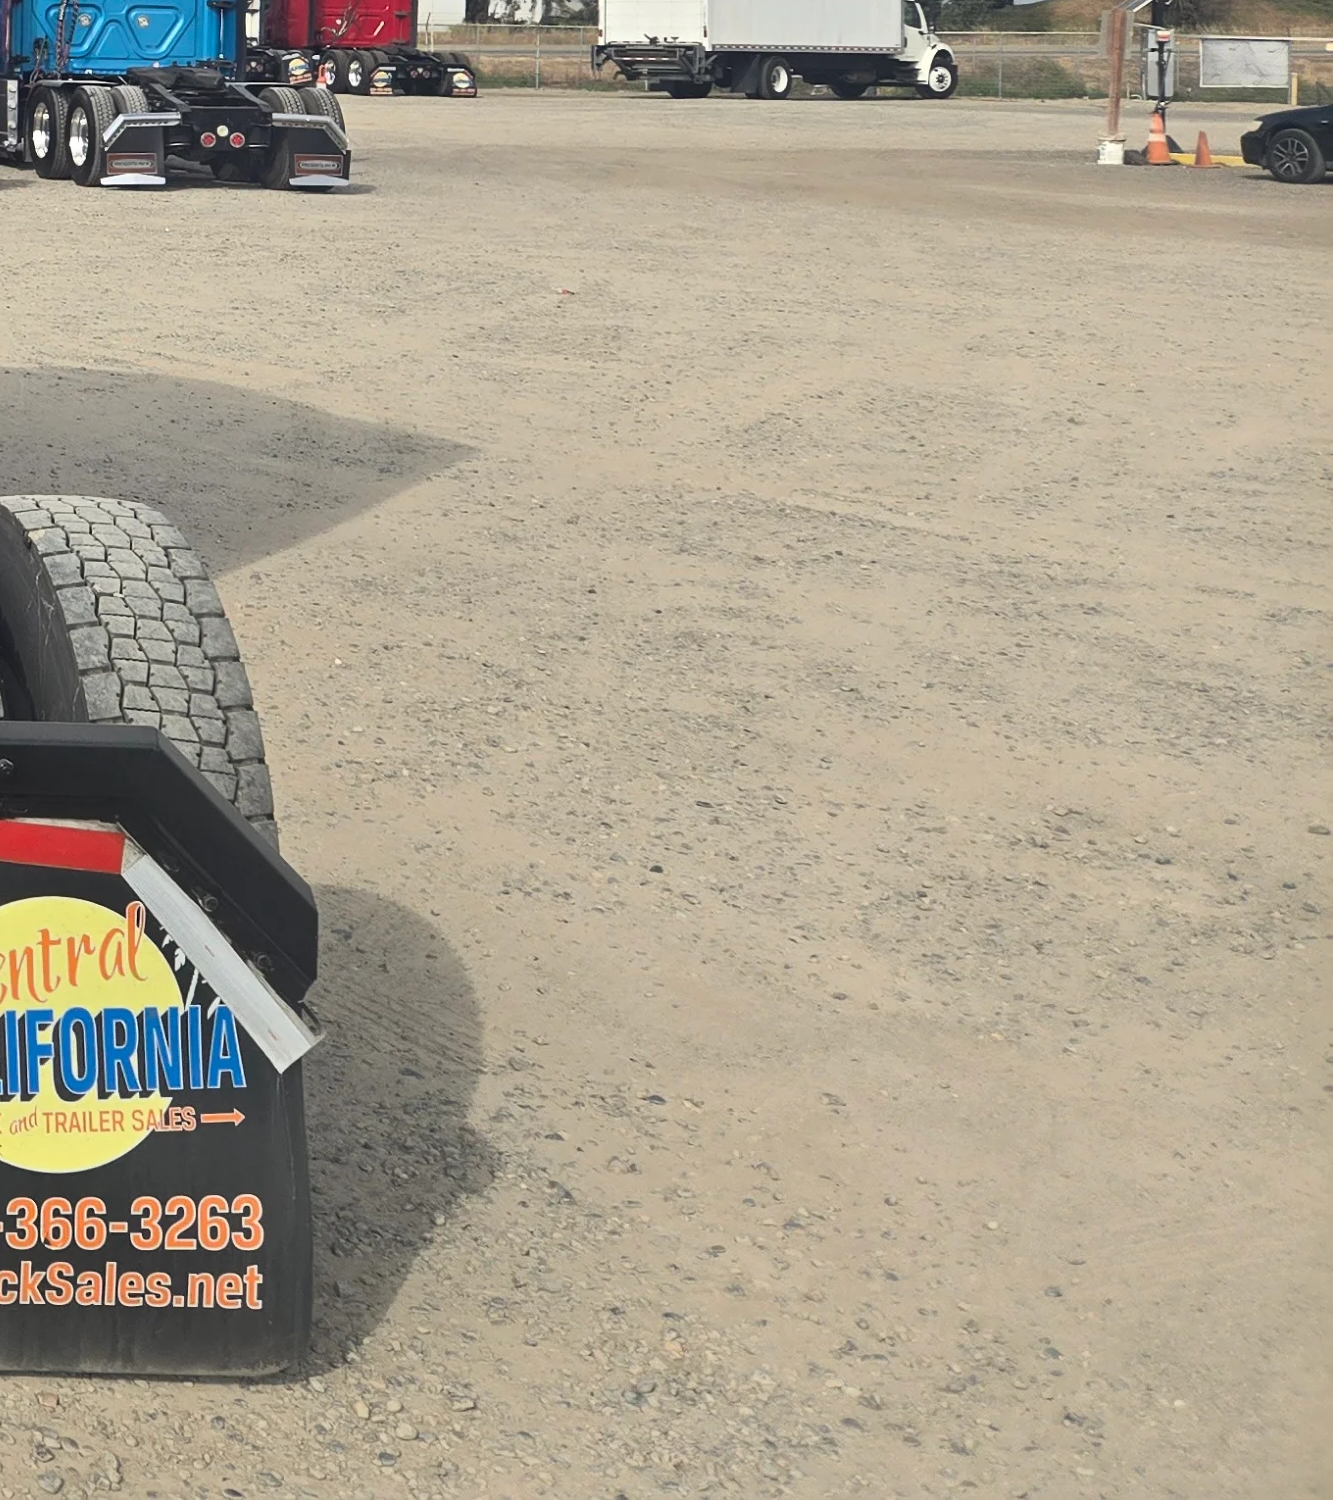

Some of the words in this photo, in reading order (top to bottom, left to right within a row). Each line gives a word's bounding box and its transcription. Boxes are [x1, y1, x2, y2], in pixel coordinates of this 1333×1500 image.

[9, 1105, 38, 1136] and
[42, 1110, 125, 1134] TRAILER
[131, 1106, 196, 1132] SALES
